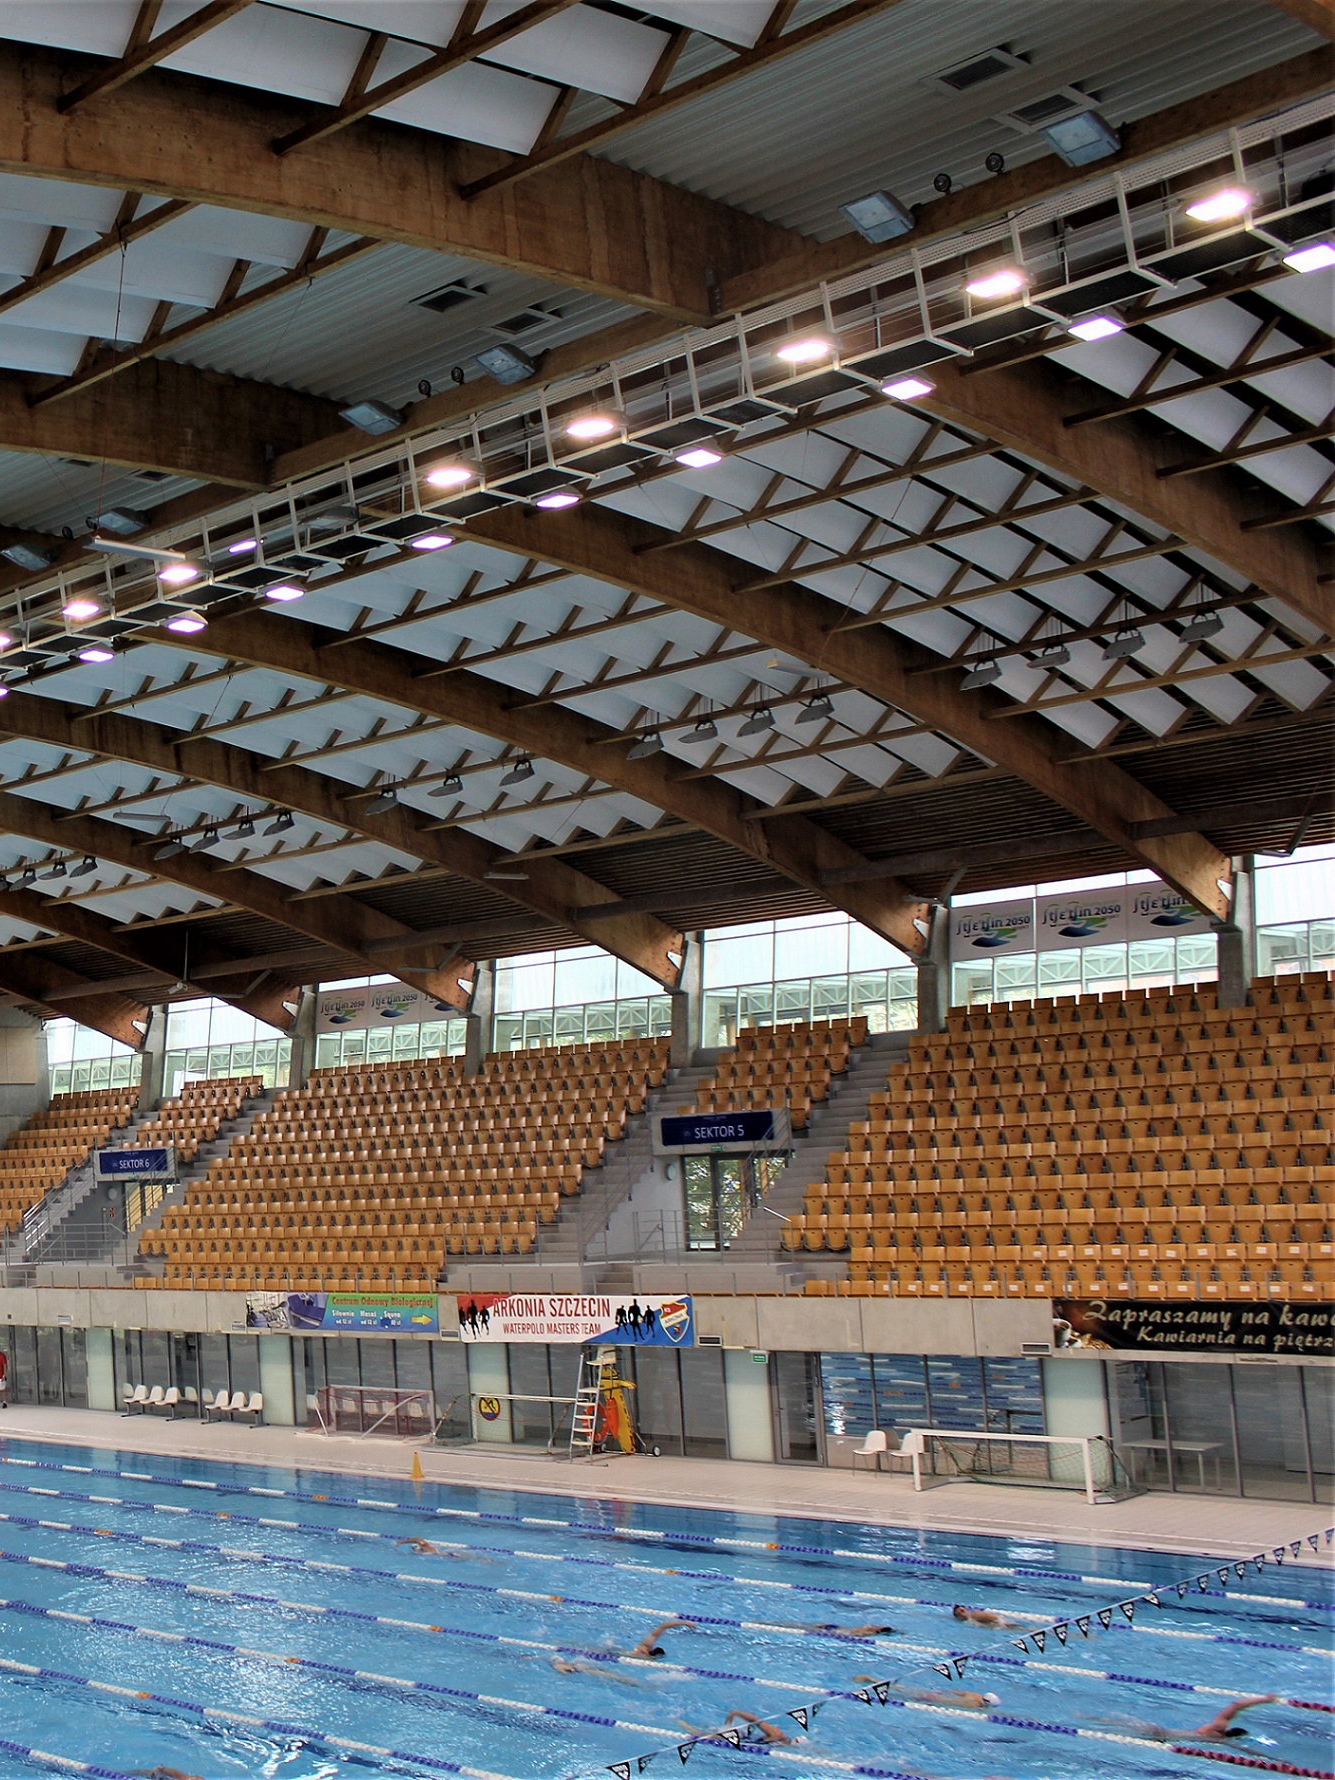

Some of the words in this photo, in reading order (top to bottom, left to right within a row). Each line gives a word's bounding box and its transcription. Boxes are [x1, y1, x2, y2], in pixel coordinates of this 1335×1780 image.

[1094, 905, 1121, 916] 2050
[1007, 916, 1030, 926] 2050
[694, 1125, 735, 1139] SEKTOR
[737, 1125, 745, 1136] 5
[119, 1159, 144, 1169] SEKTOR
[145, 1158, 150, 1168] 6
[332, 1297, 359, 1305] Centrum
[361, 1297, 388, 1306] Odnowy
[391, 1297, 433, 1308] Biologicznej
[493, 1298, 546, 1317] ARKONIA
[549, 1298, 610, 1317] SZCZECIN
[1083, 1301, 1232, 1331] Zapraszamy
[1241, 1312, 1269, 1325] na
[503, 1322, 545, 1334] WATERPOLO
[546, 1323, 580, 1334] MASTERS
[581, 1323, 601, 1334] TEAM
[1137, 1326, 1236, 1345] Kawiarnia
[1243, 1334, 1266, 1345] na
